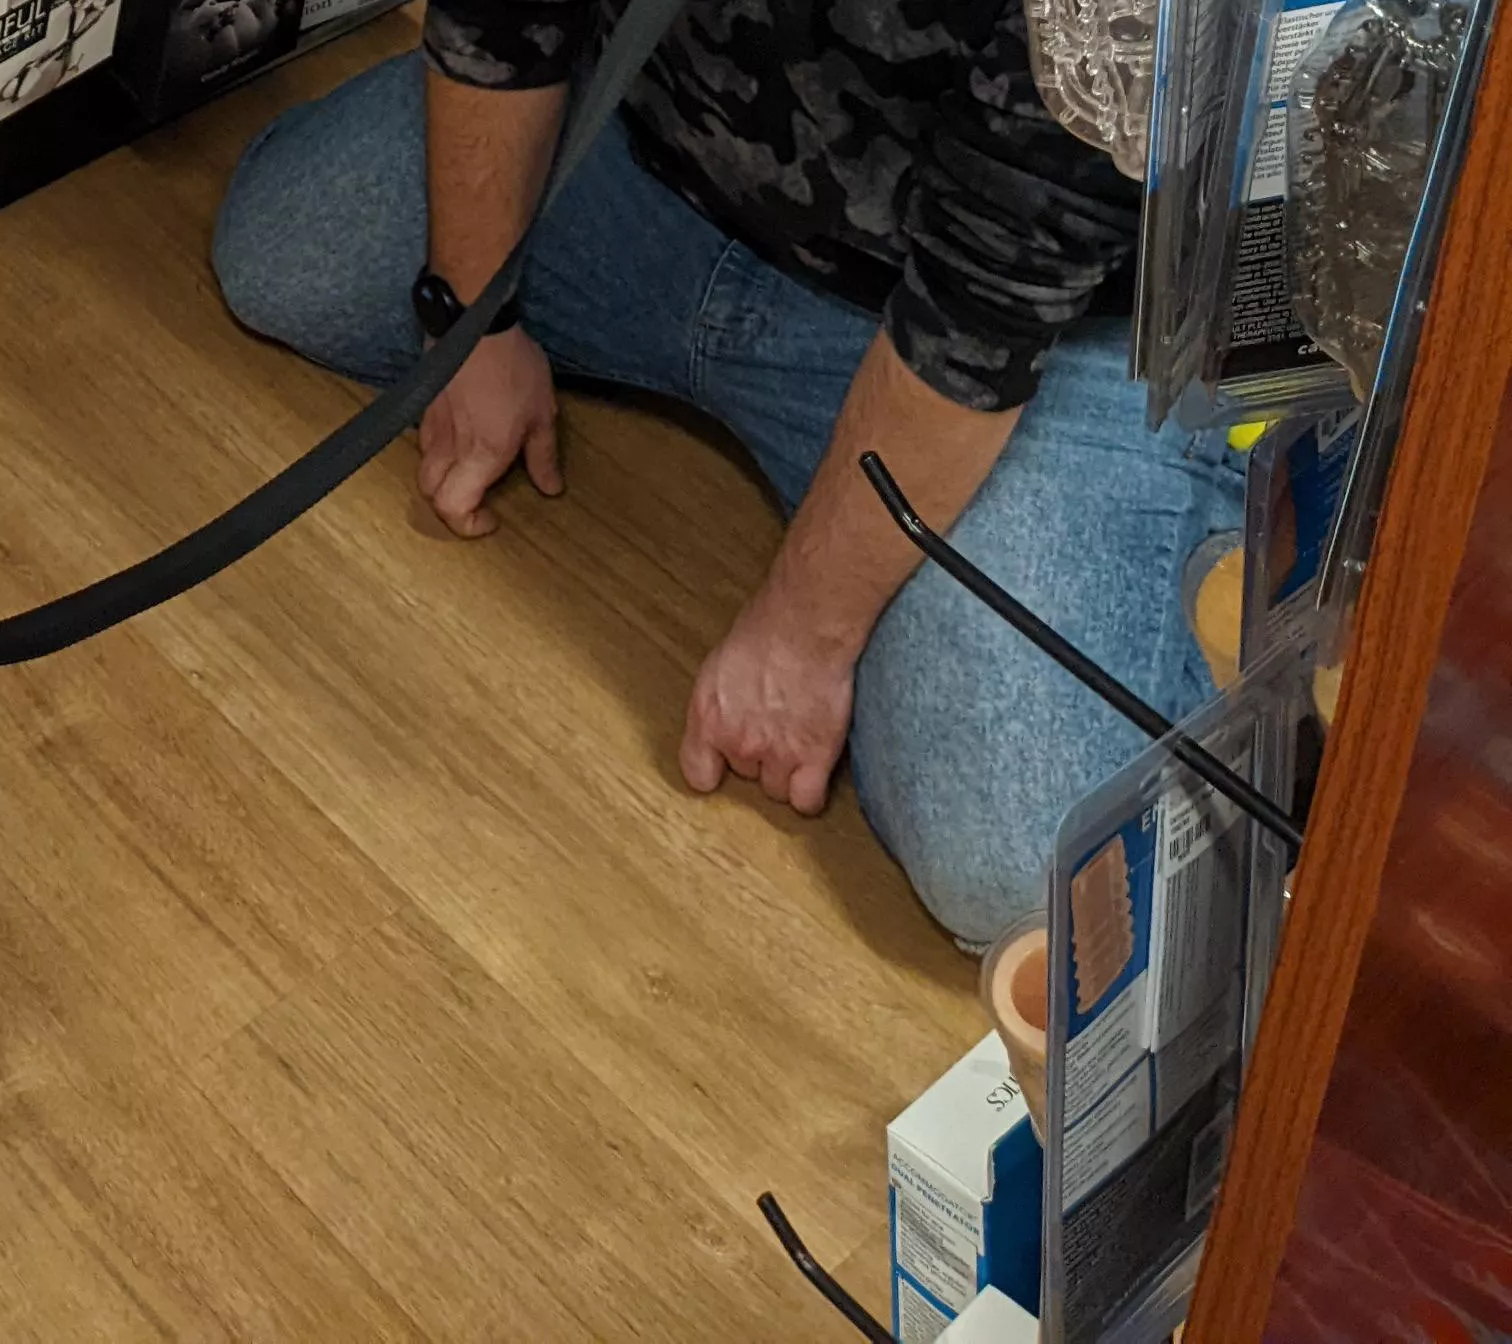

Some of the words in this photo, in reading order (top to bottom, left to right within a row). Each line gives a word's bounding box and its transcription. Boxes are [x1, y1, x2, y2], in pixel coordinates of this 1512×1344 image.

[21, 23, 45, 50] KIT
[890, 1161, 915, 1187] DUAL
[915, 1182, 980, 1237] PENETRATOR
